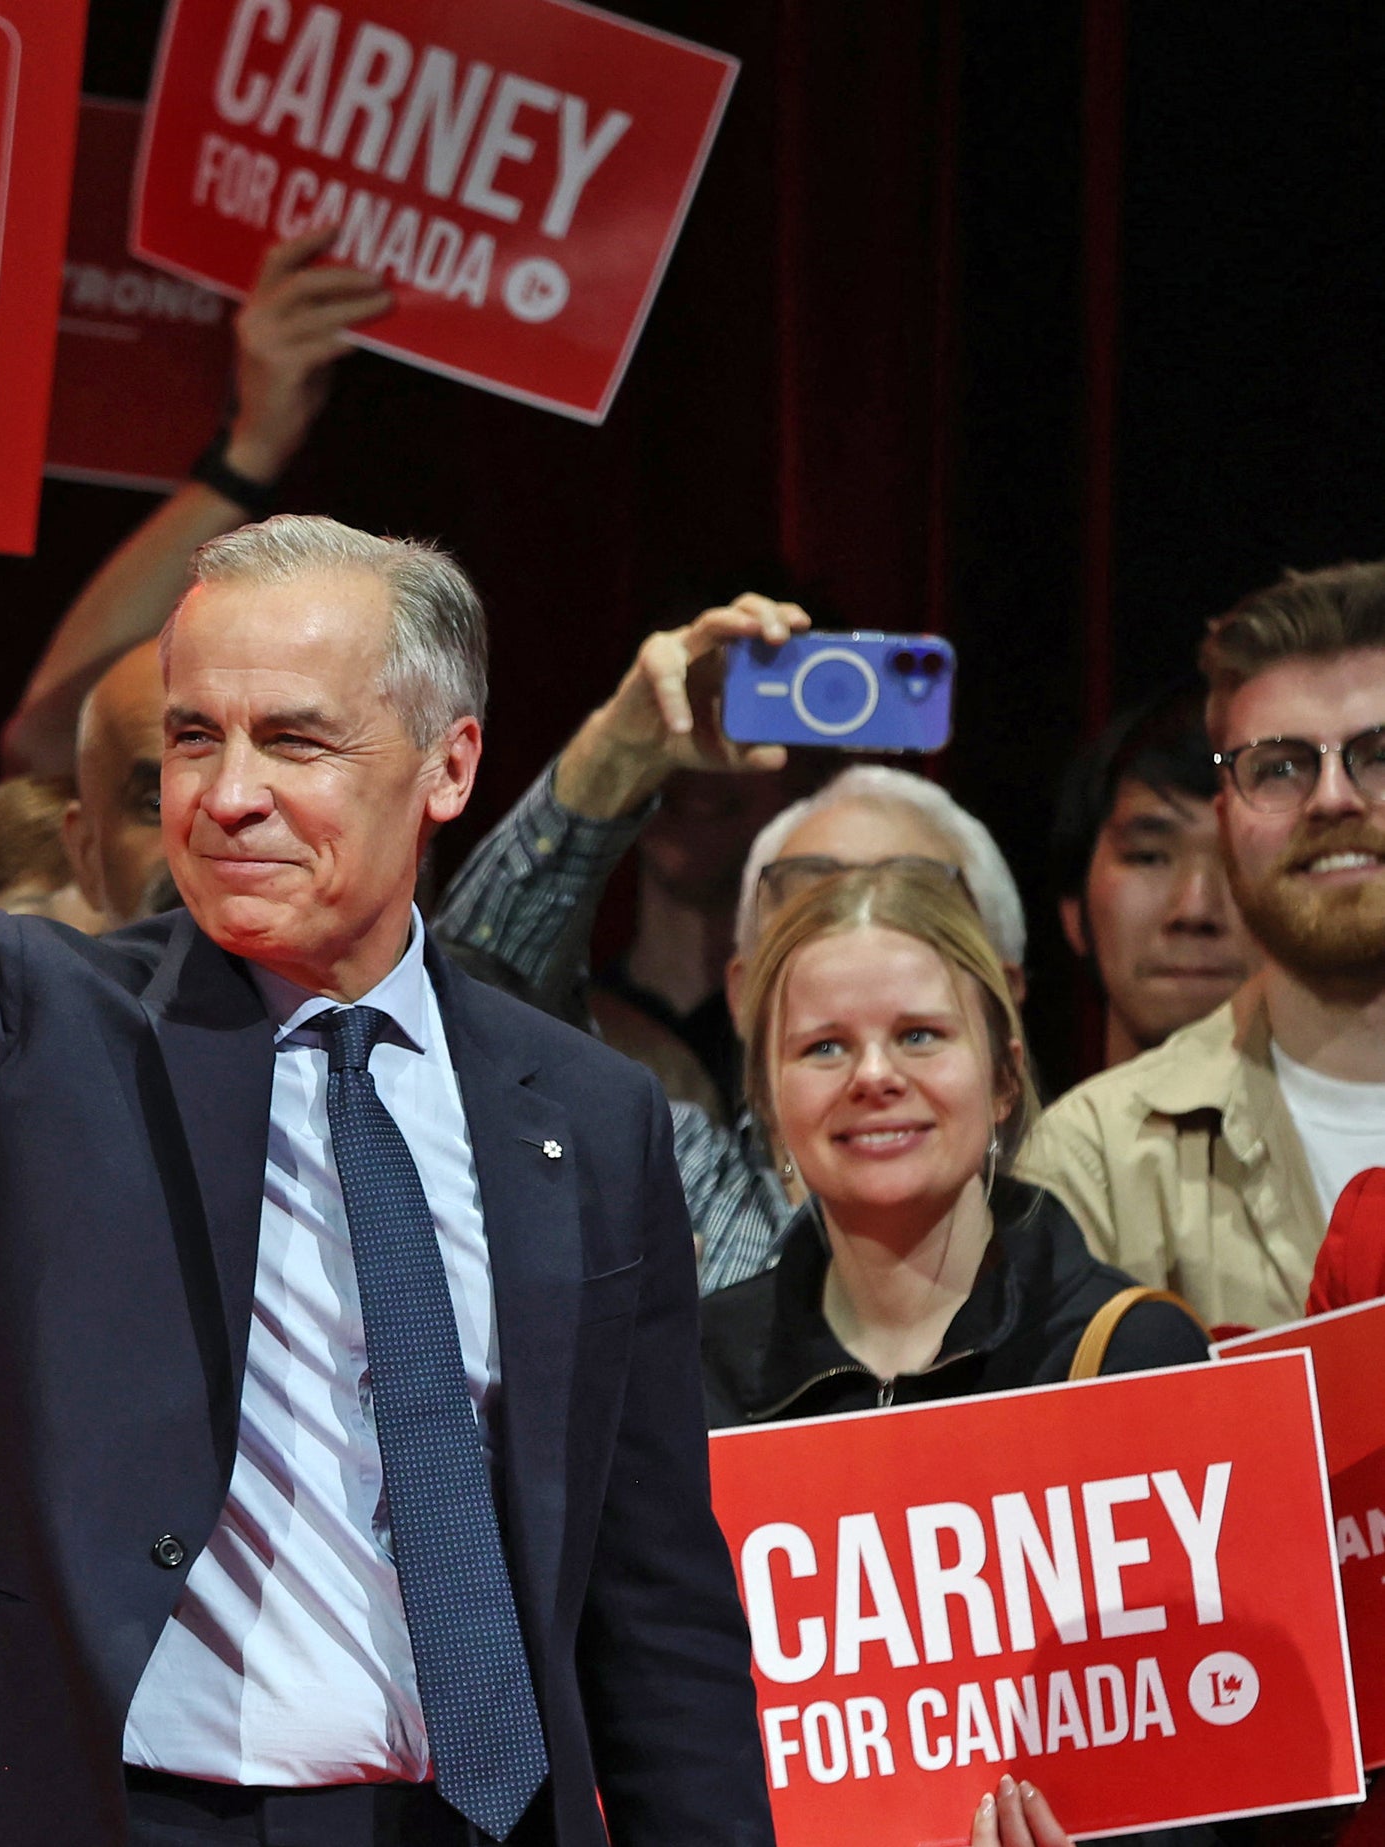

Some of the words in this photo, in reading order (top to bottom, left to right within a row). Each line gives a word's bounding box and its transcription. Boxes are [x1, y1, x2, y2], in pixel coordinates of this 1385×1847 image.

[215, 0, 633, 240] CARNEY
[193, 133, 278, 231] FOR
[274, 167, 496, 308] CANADA
[740, 1461, 1233, 1685] CARNEY
[763, 1697, 895, 1789] FOR
[906, 1657, 1177, 1772] CANADA
